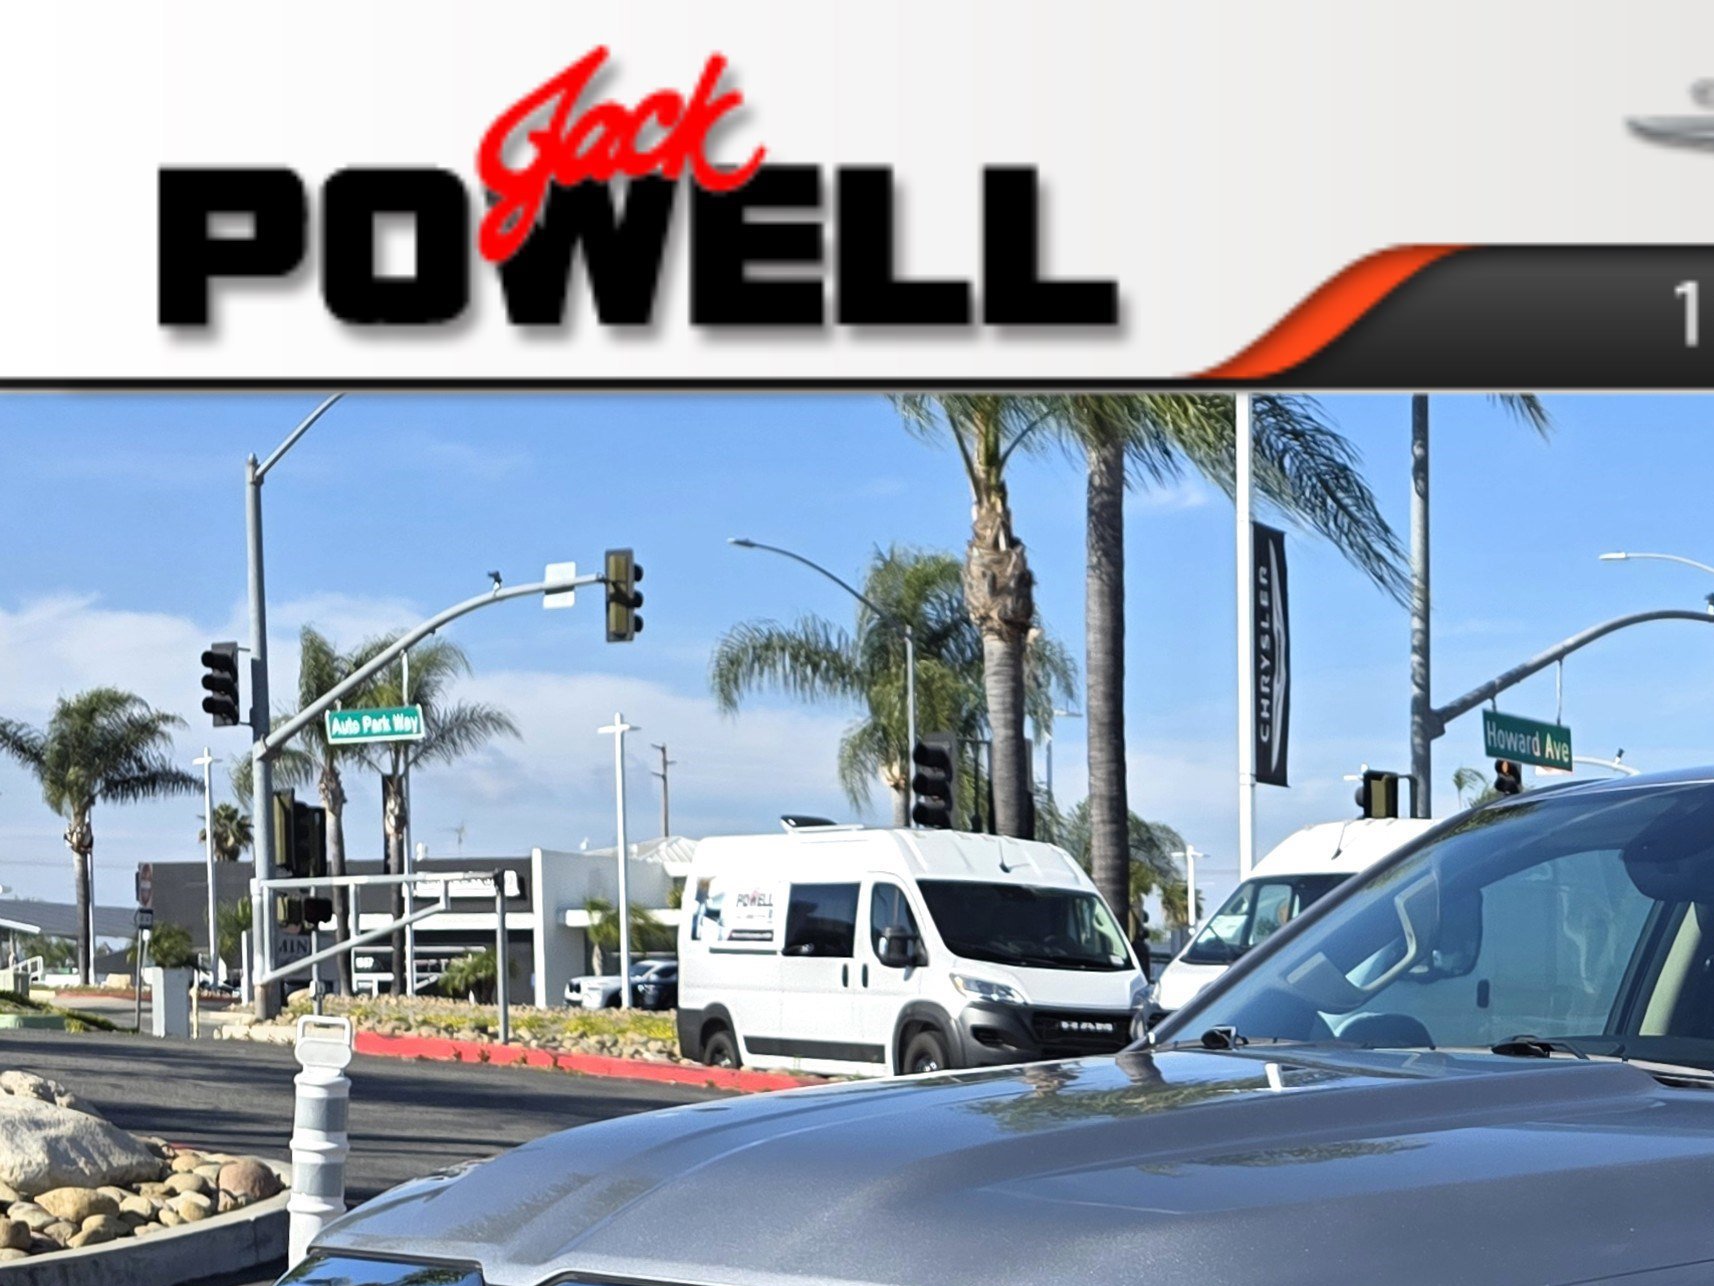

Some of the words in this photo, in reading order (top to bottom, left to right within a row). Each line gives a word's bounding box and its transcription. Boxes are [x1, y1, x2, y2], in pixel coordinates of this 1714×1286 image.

[1258, 565, 1271, 743] CHRYSLER
[332, 716, 360, 736] Auto
[362, 714, 392, 734] Park
[392, 713, 418, 733] Way
[1486, 720, 1541, 757] Howard
[1545, 732, 1570, 763] Ave
